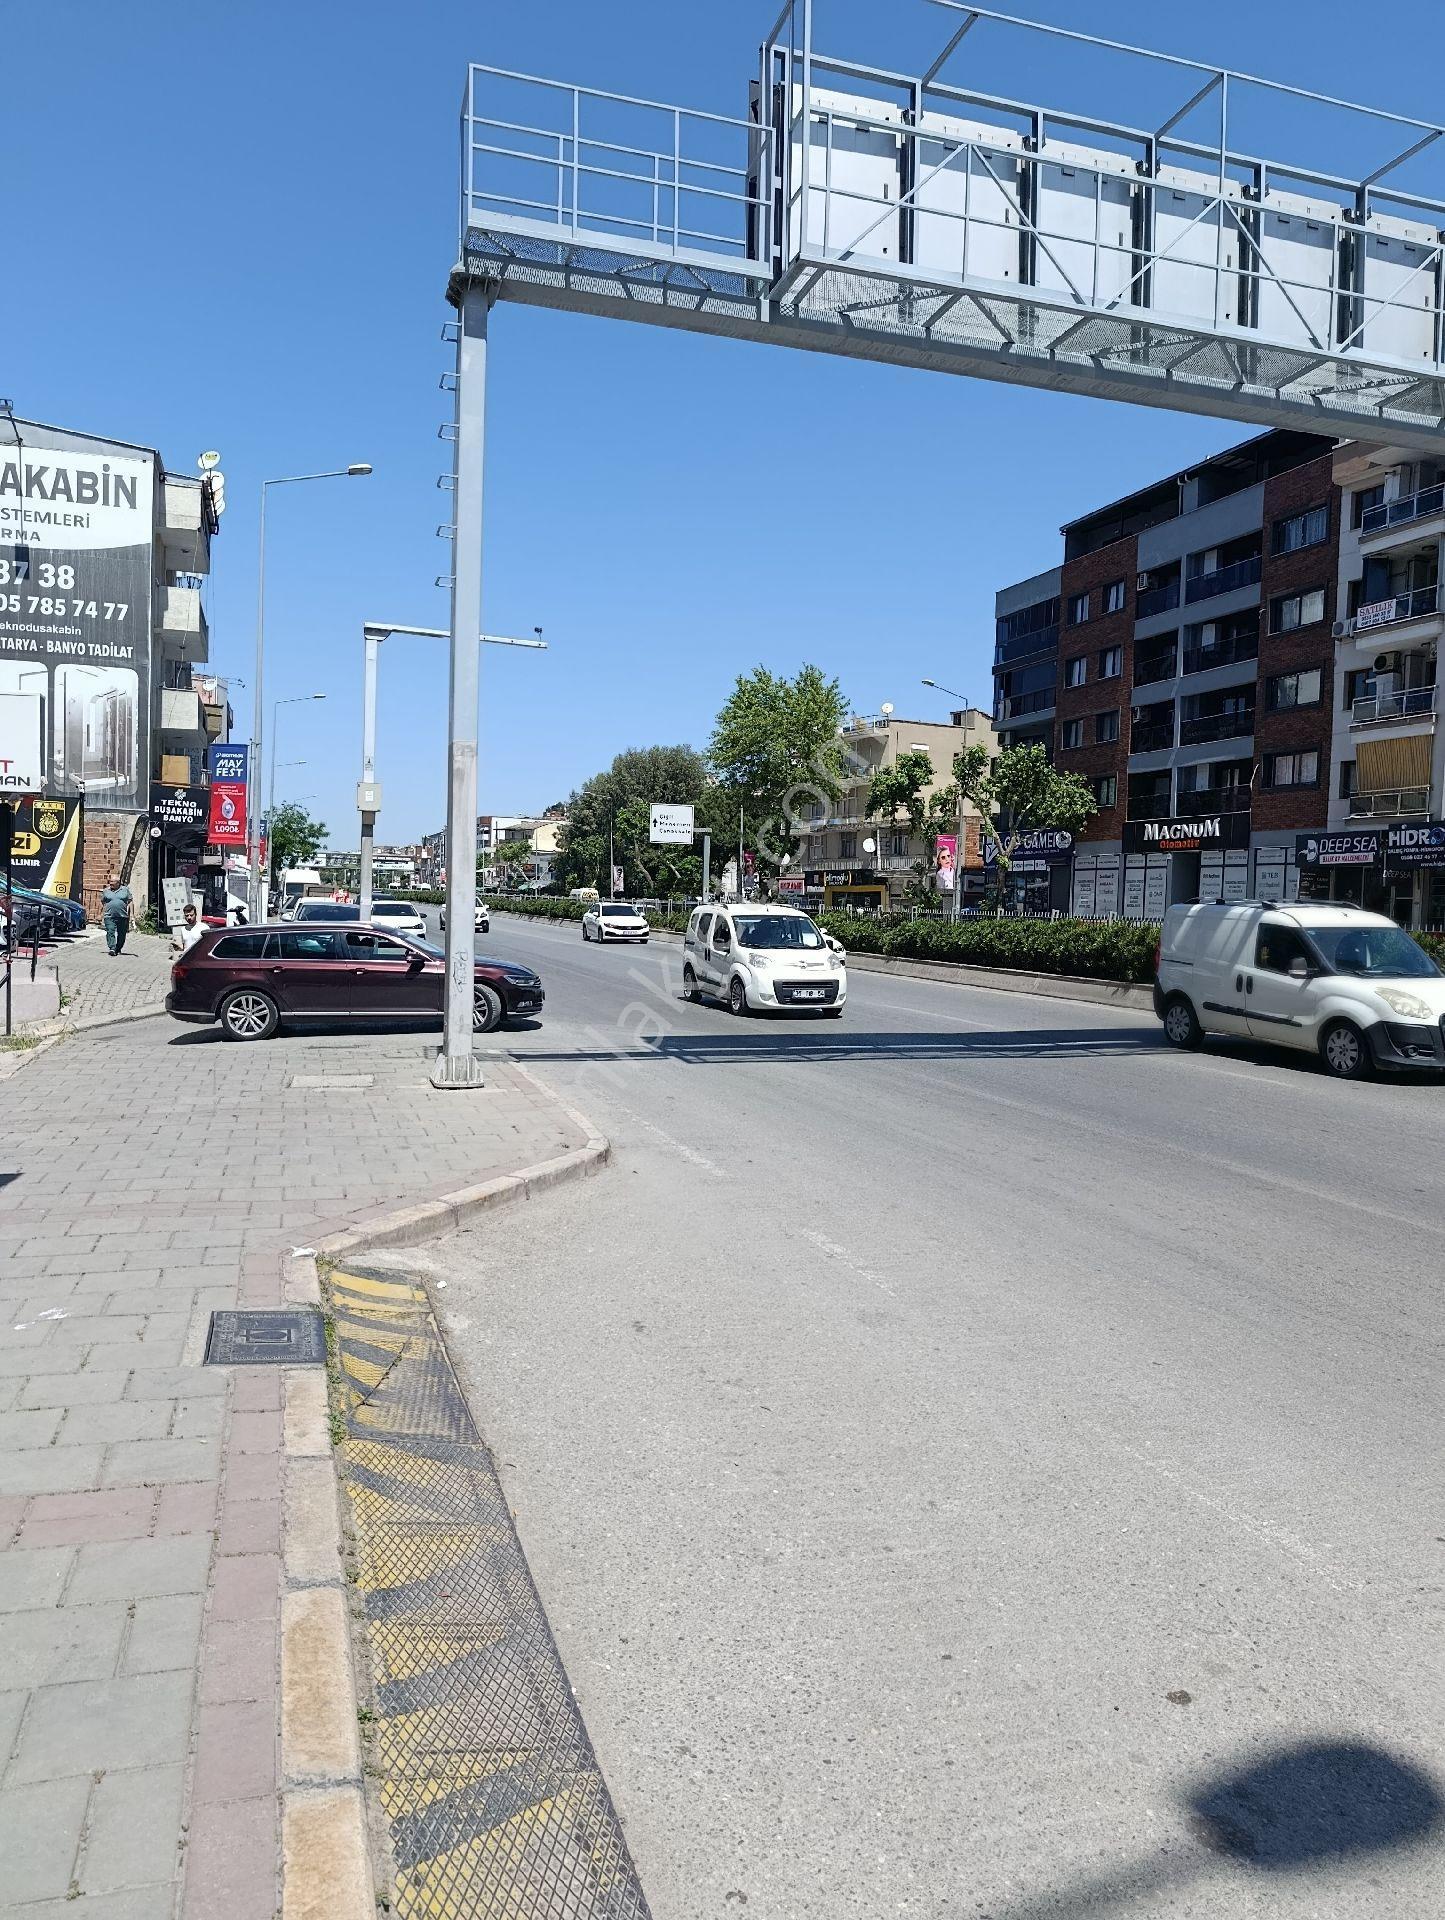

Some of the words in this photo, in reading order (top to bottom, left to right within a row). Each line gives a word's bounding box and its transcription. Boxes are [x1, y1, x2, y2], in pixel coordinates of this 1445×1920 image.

[38, 563, 75, 590] 38
[27, 596, 66, 616] 785
[72, 599, 98, 618] 74
[103, 602, 129, 621] 77
[1359, 600, 1394, 617] SATILIK
[0, 637, 38, 652] TARYA
[46, 640, 86, 655] BANYO
[88, 642, 133, 658] TADİLAT
[215, 767, 244, 777] FEST
[216, 759, 244, 768] MAY
[0, 776, 30, 787] AN
[160, 799, 197, 808] TEKNO
[163, 814, 194, 823] BANYO
[1143, 817, 1221, 841] MAGNUM
[1320, 837, 1352, 853] DEEP
[1352, 836, 1378, 852] SEA
